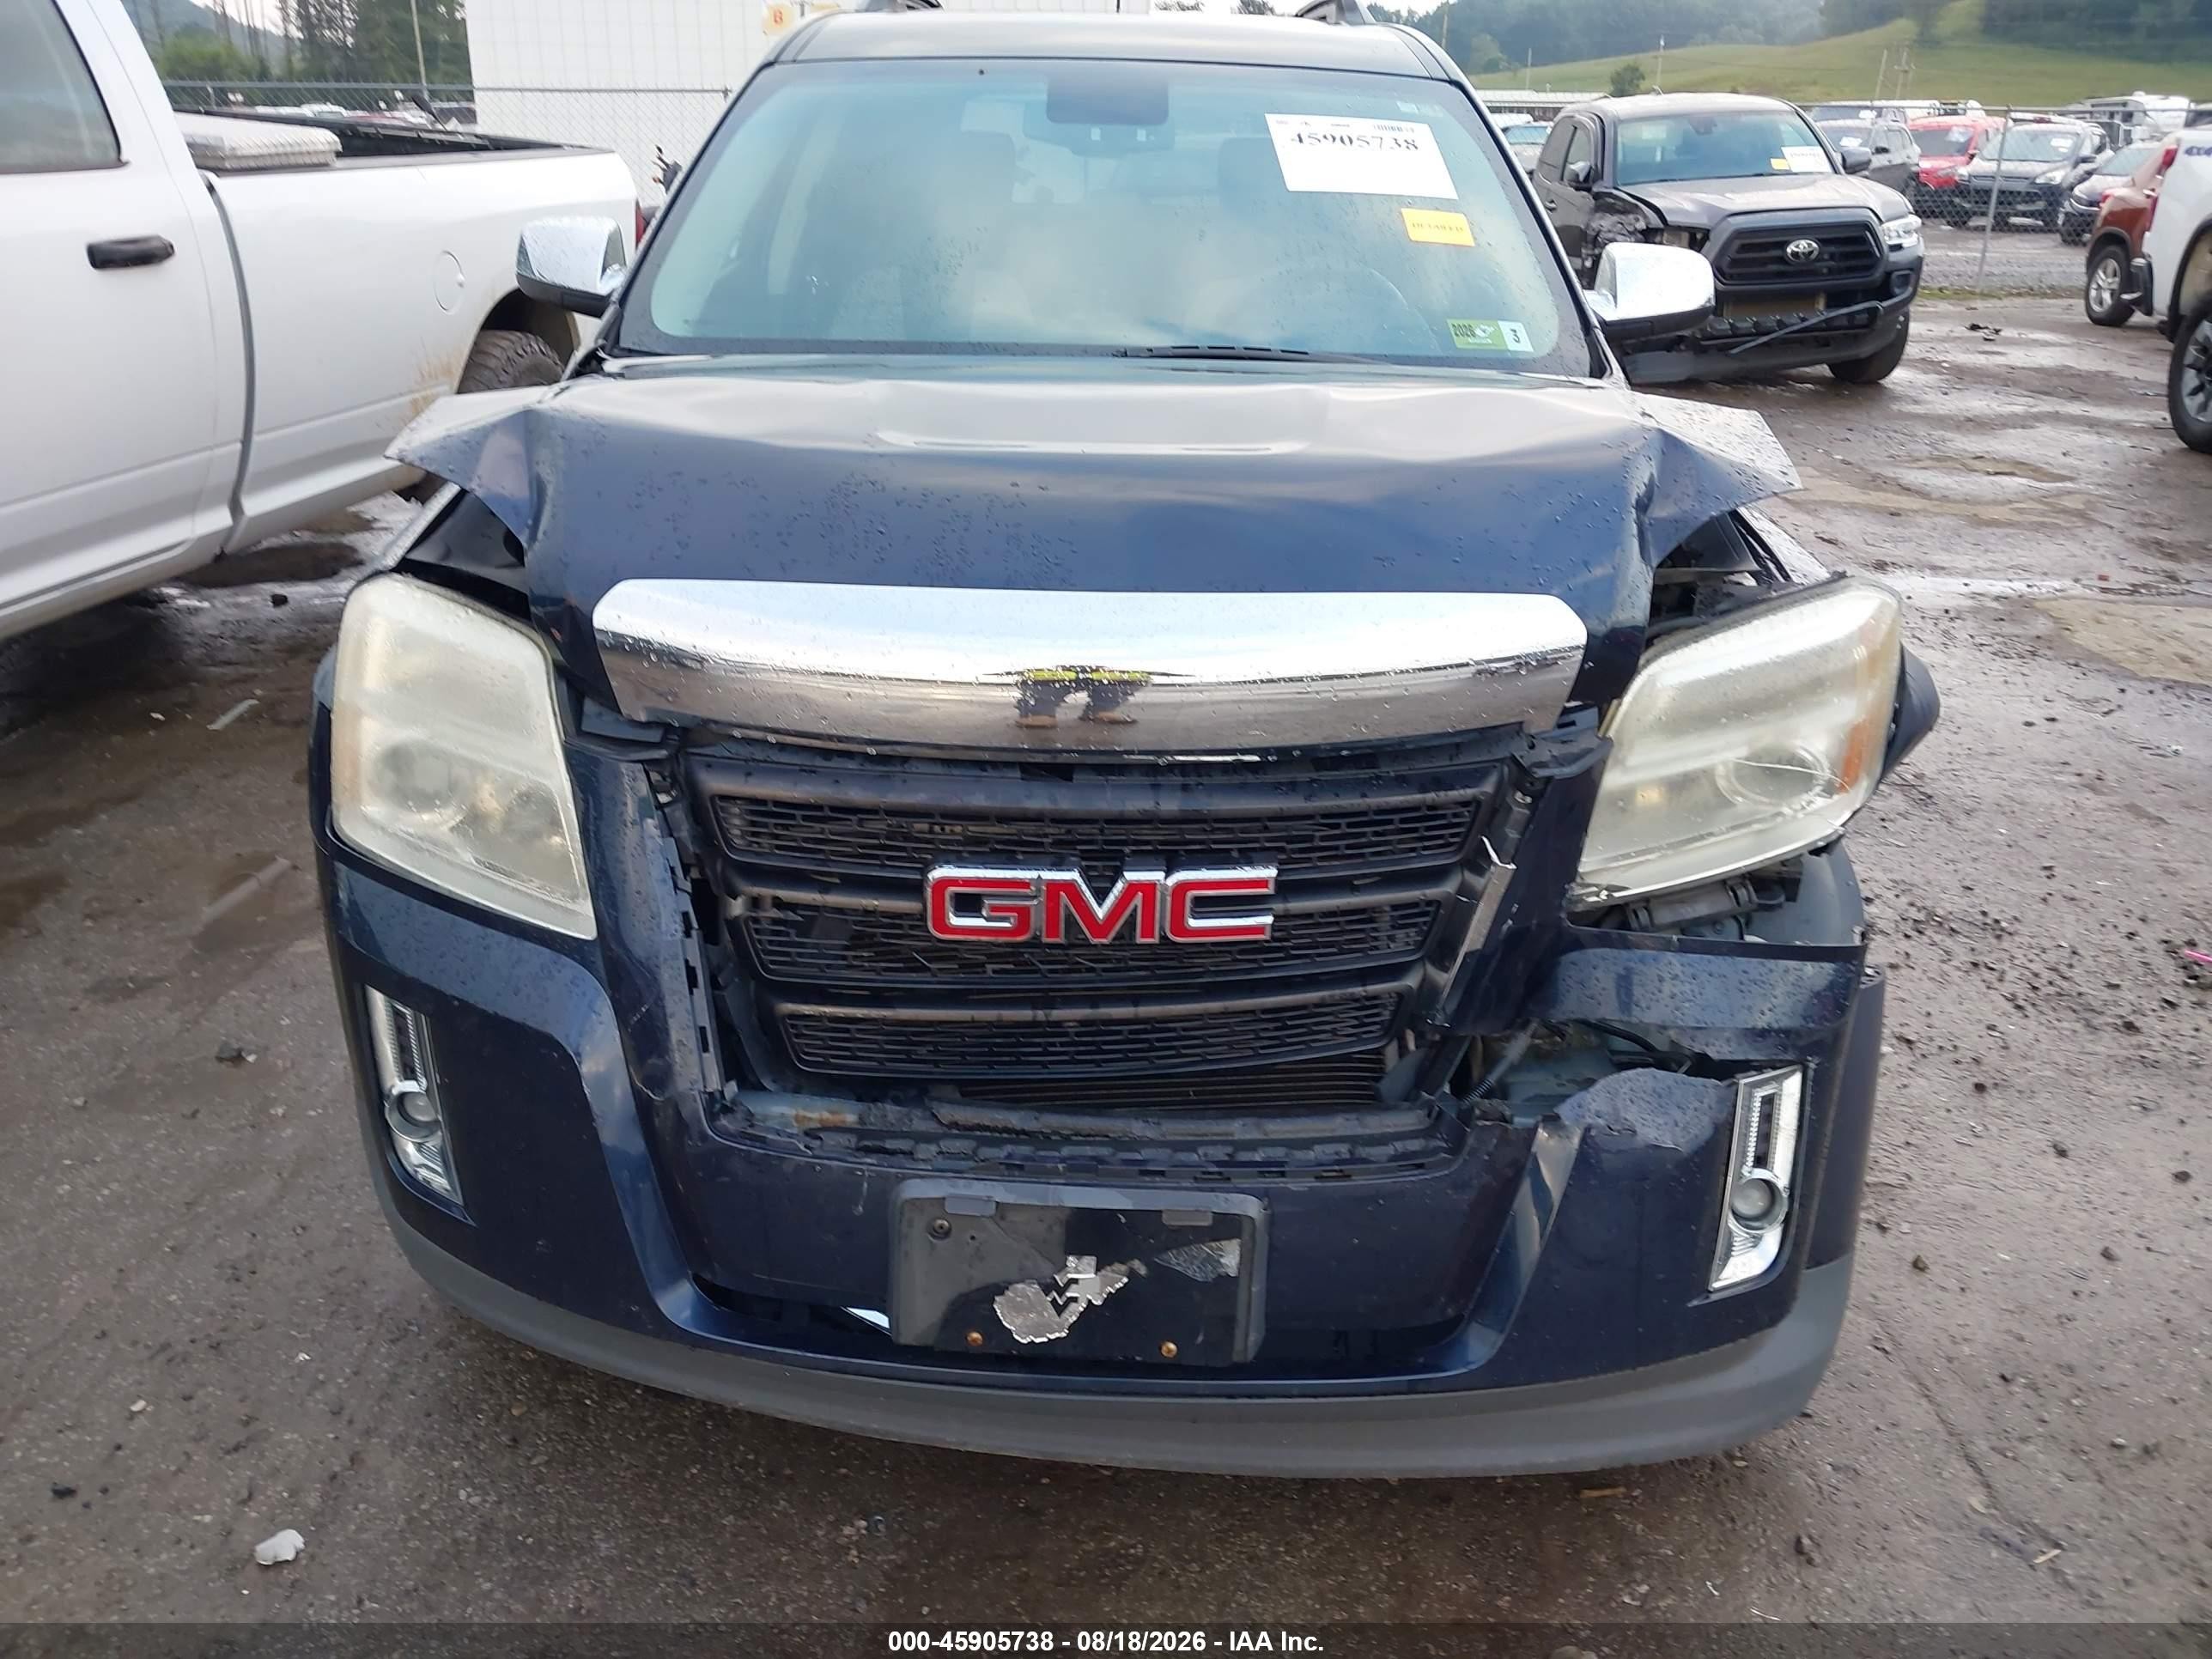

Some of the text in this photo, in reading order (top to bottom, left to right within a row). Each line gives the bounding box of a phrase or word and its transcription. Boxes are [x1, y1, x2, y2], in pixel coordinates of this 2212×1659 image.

[1291, 132, 1419, 150] 45905738
[1452, 323, 1477, 337] 2026
[1510, 328, 1522, 343] 3
[927, 866, 1278, 944] GMC
